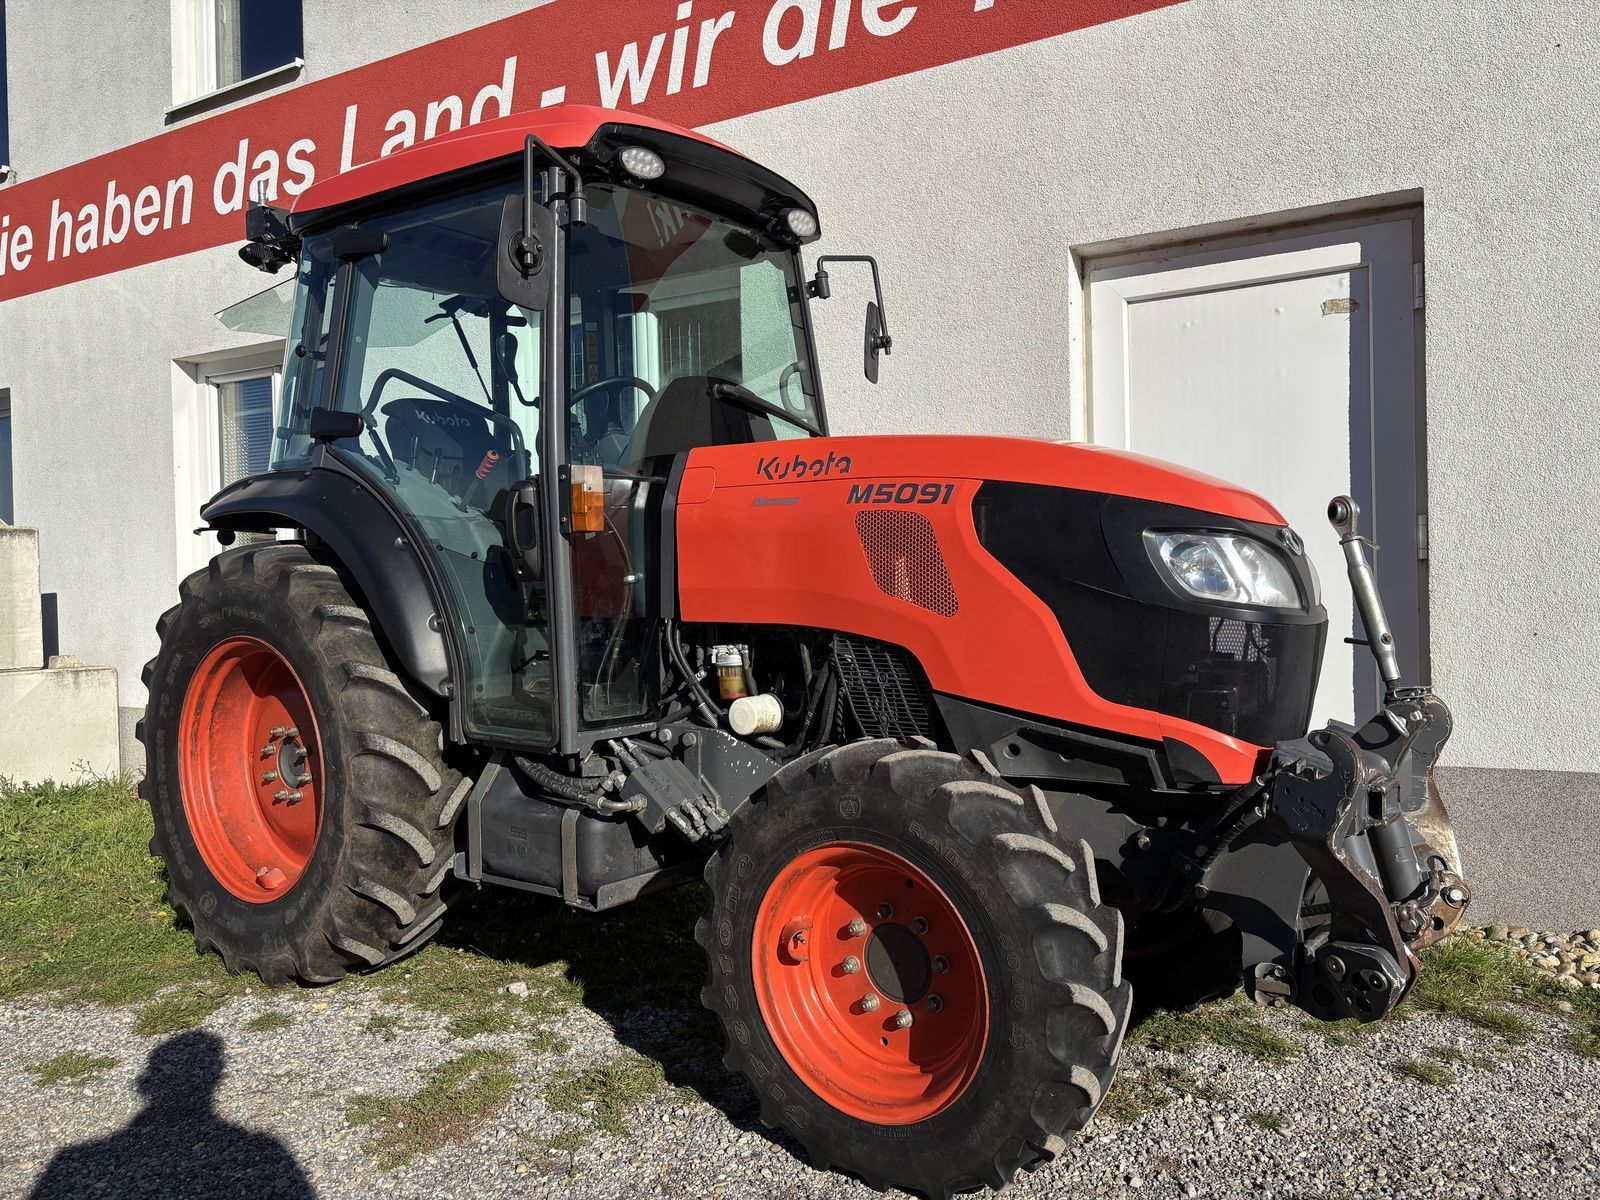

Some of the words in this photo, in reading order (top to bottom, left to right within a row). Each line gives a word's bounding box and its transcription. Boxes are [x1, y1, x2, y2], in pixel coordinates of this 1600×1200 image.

[0, 215, 33, 276] ie
[47, 173, 193, 262] haben
[213, 138, 316, 215] das
[340, 56, 517, 174] Land
[595, 0, 735, 110] wir
[415, 409, 471, 427] Kubota
[756, 451, 851, 480] Kubota
[846, 483, 955, 505] M5091
[907, 820, 998, 920] RADIAL
